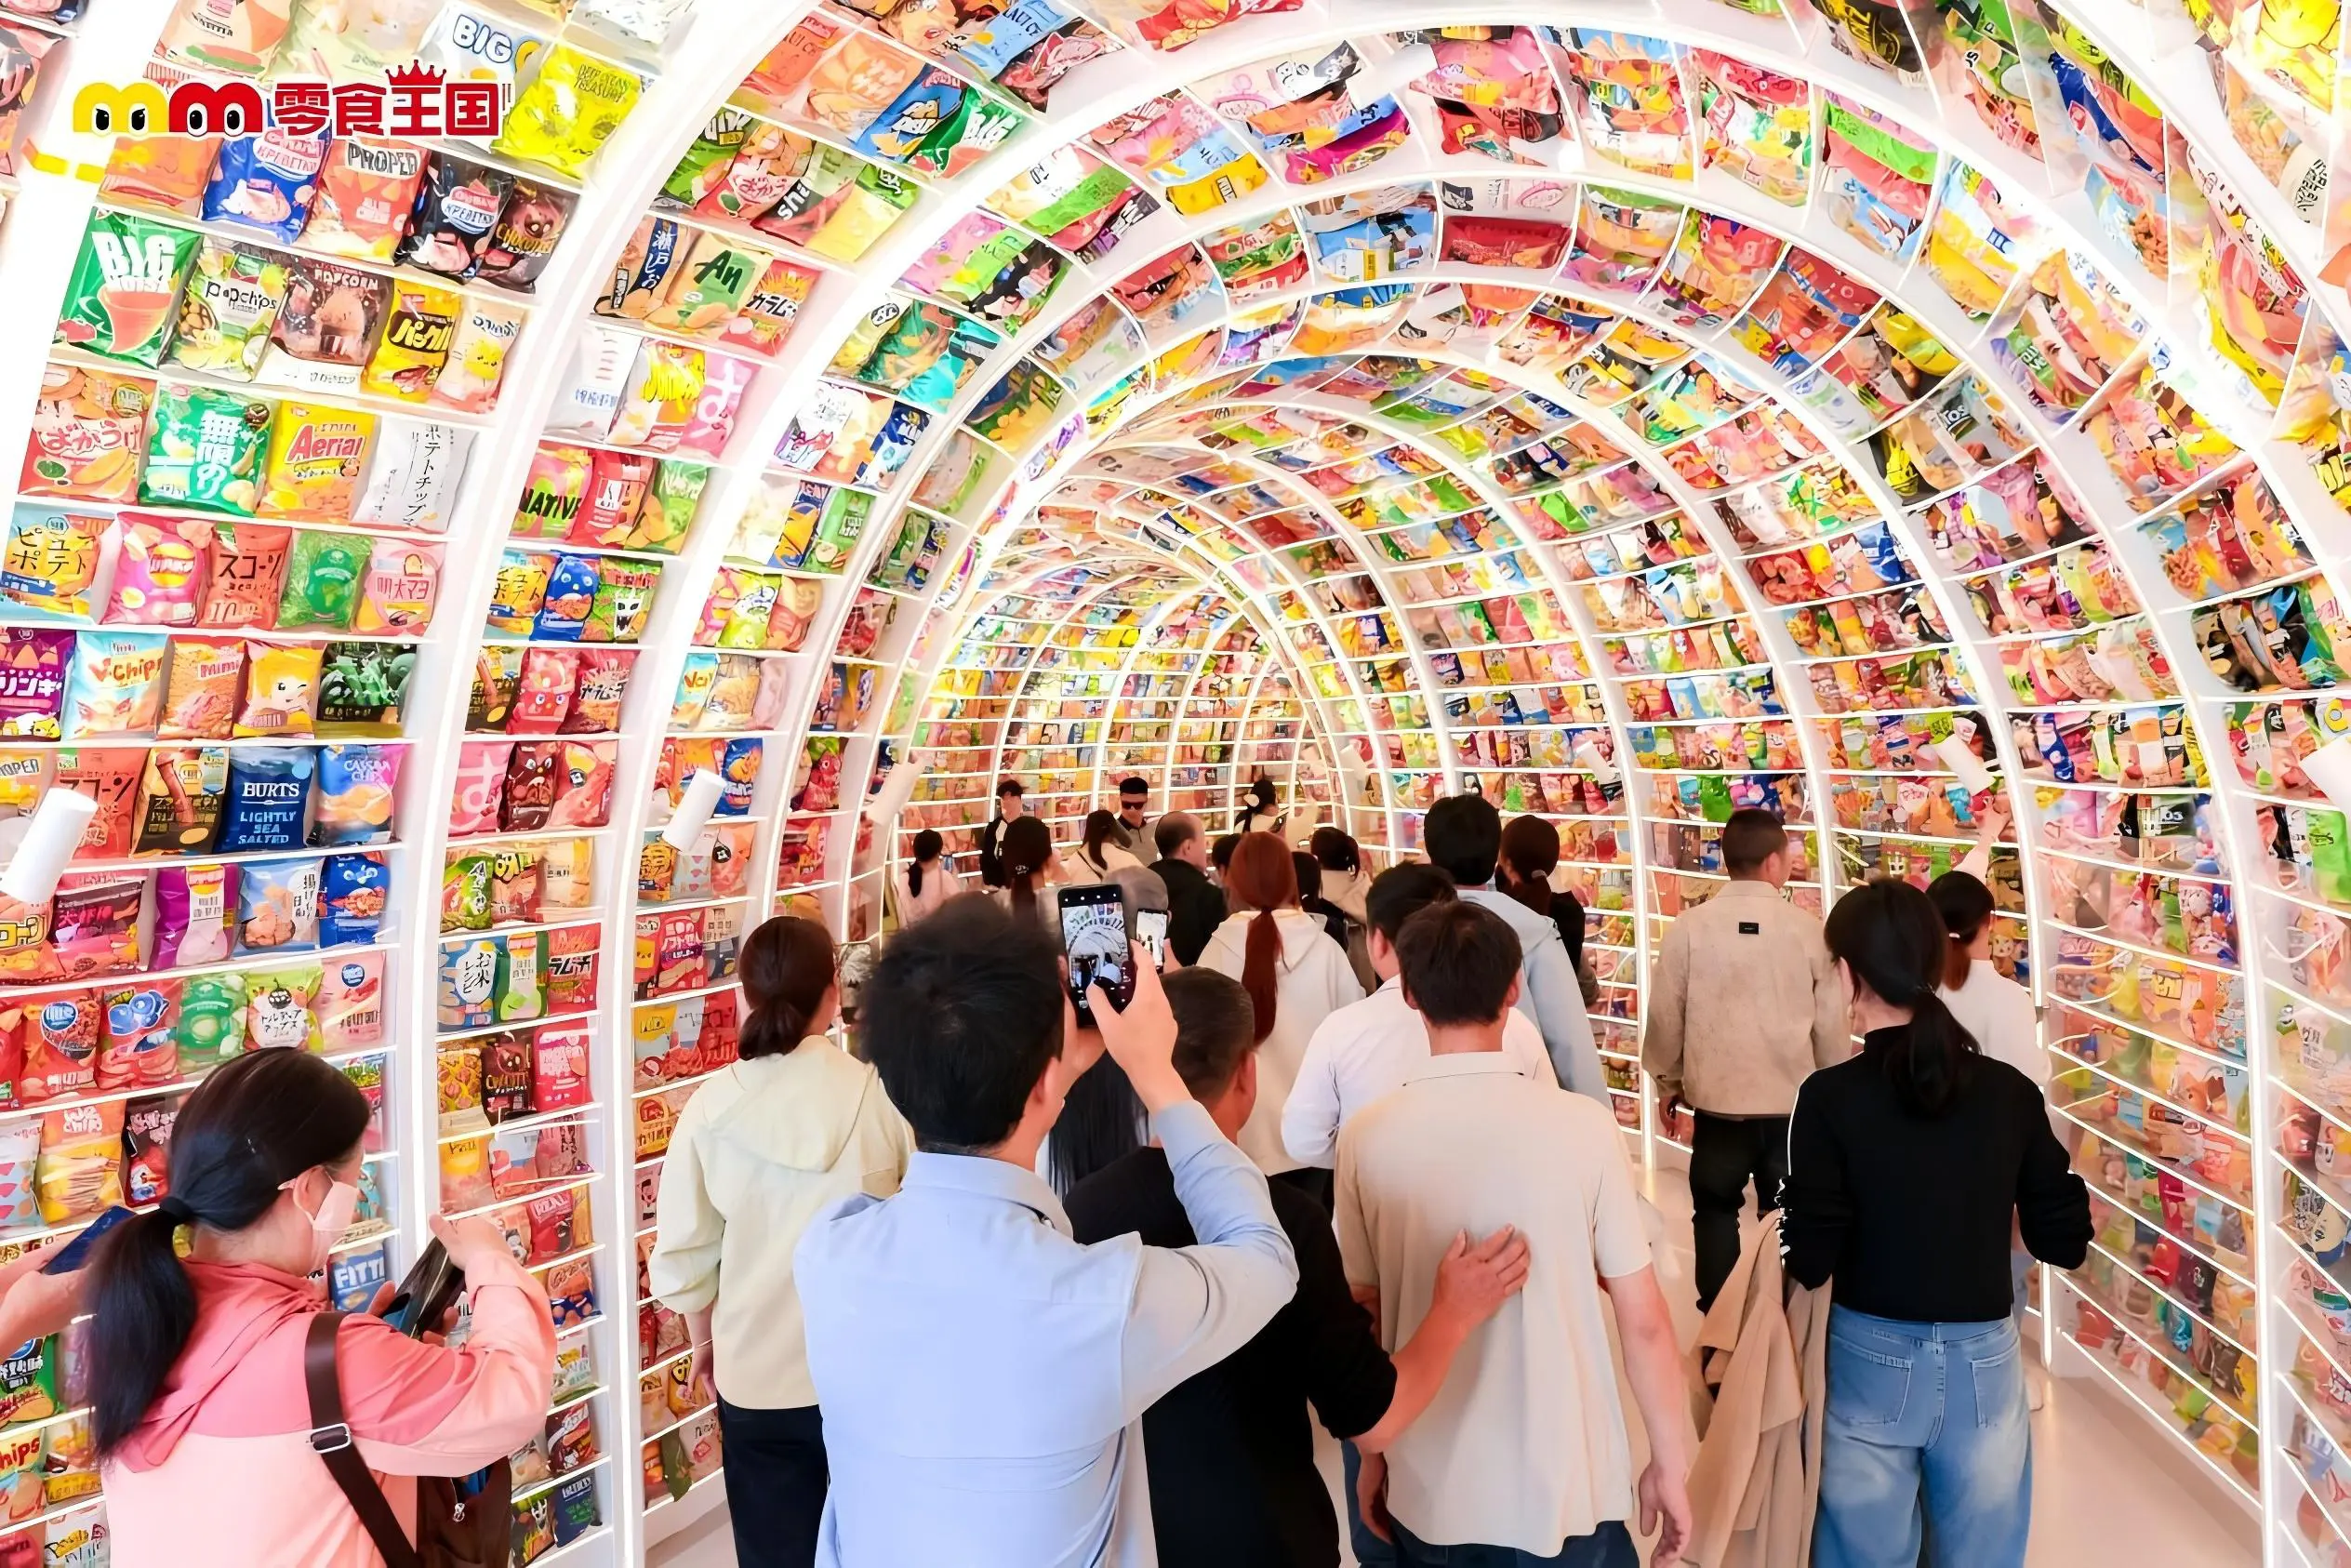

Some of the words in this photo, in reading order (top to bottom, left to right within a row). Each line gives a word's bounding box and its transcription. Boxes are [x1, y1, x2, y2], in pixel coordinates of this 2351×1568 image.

[452, 14, 512, 64] BIG
[91, 232, 178, 281] BIG
[286, 425, 363, 462] Aerial
[10, 550, 87, 578] ポテト
[218, 552, 282, 579] スコーン
[243, 781, 300, 798] BURTS
[240, 811, 297, 824] LIGHTLY
[253, 824, 281, 834] SEA
[238, 834, 290, 845] SALTED
